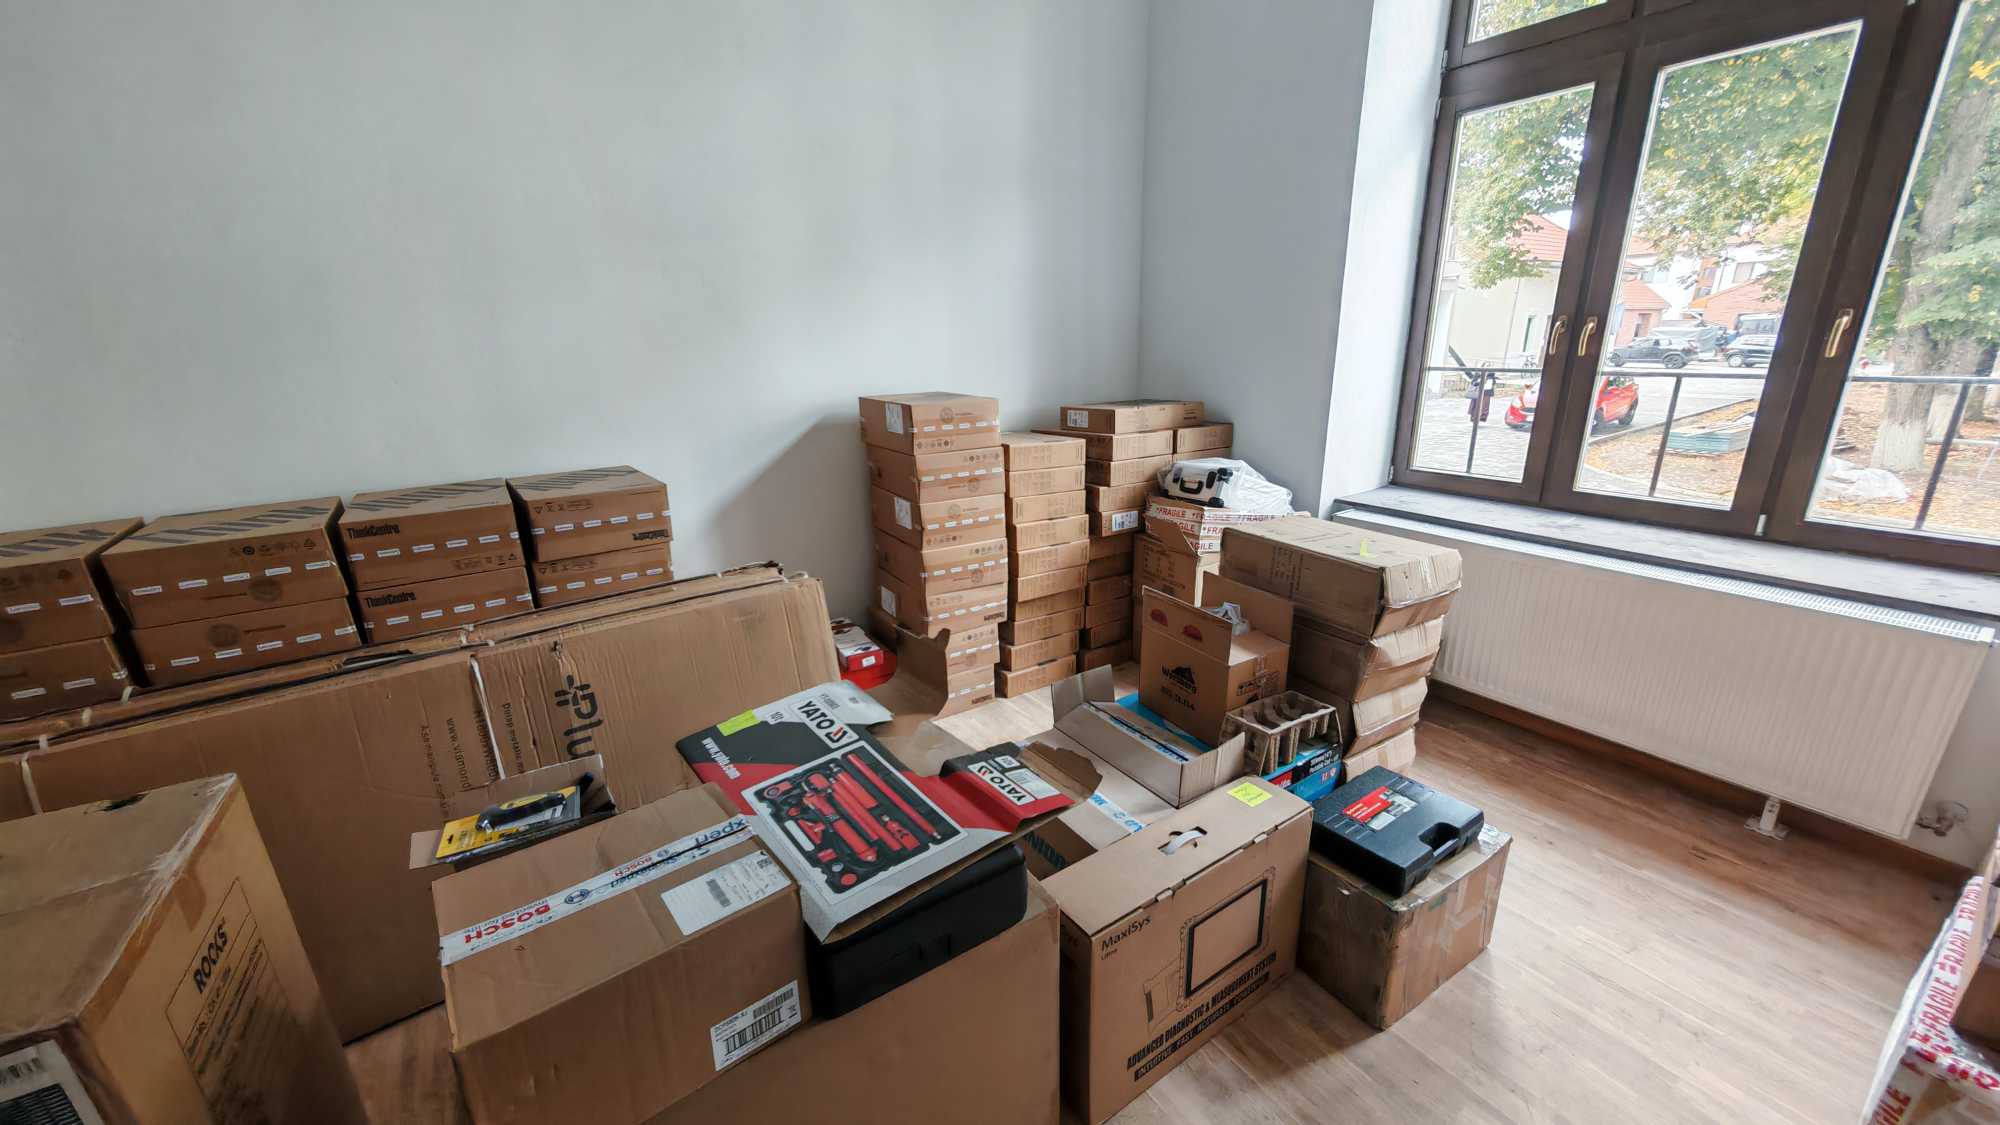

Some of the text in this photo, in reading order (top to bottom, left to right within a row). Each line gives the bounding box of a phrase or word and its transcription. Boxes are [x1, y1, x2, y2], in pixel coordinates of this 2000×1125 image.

[797, 700, 836, 730] YATO
[989, 775, 1027, 803] YATO
[464, 903, 551, 944] BOSCH
[1101, 915, 1153, 952] MaxiSys
[1919, 976, 1958, 1042] FRAGILE
